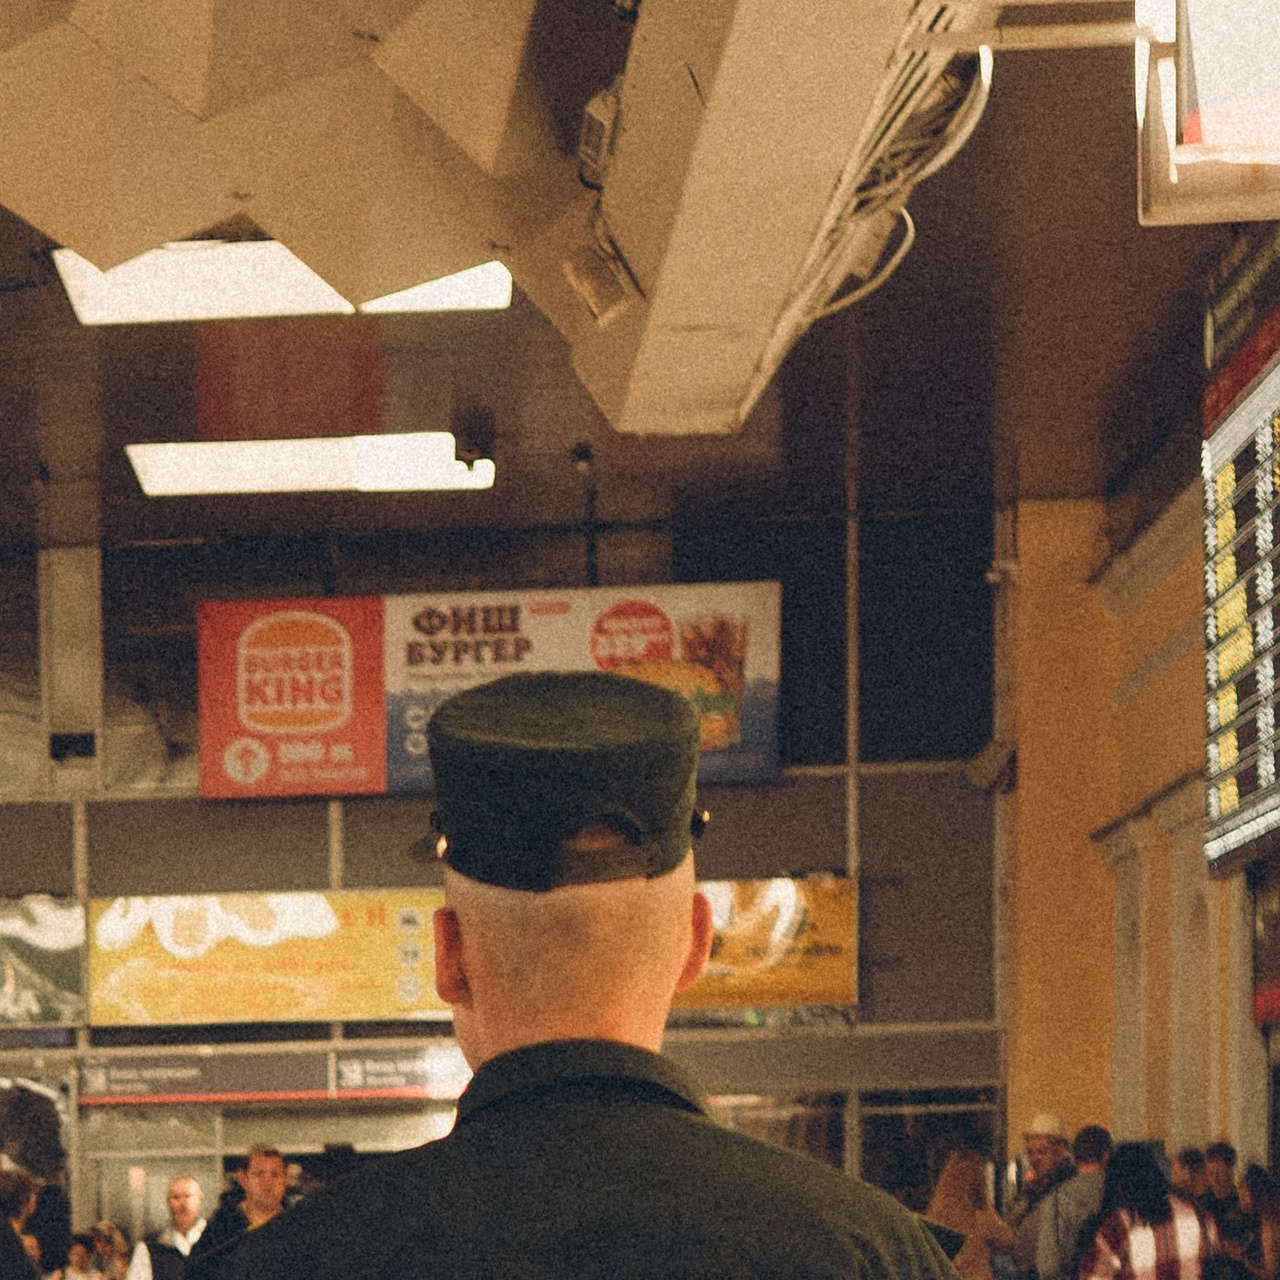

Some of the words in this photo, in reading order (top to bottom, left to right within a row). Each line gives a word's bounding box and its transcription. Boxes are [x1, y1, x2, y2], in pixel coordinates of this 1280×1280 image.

[411, 605, 521, 636] ФИШ
[245, 650, 345, 673] BURGER
[405, 637, 533, 667] БУРГЕР
[245, 673, 344, 706] KING
